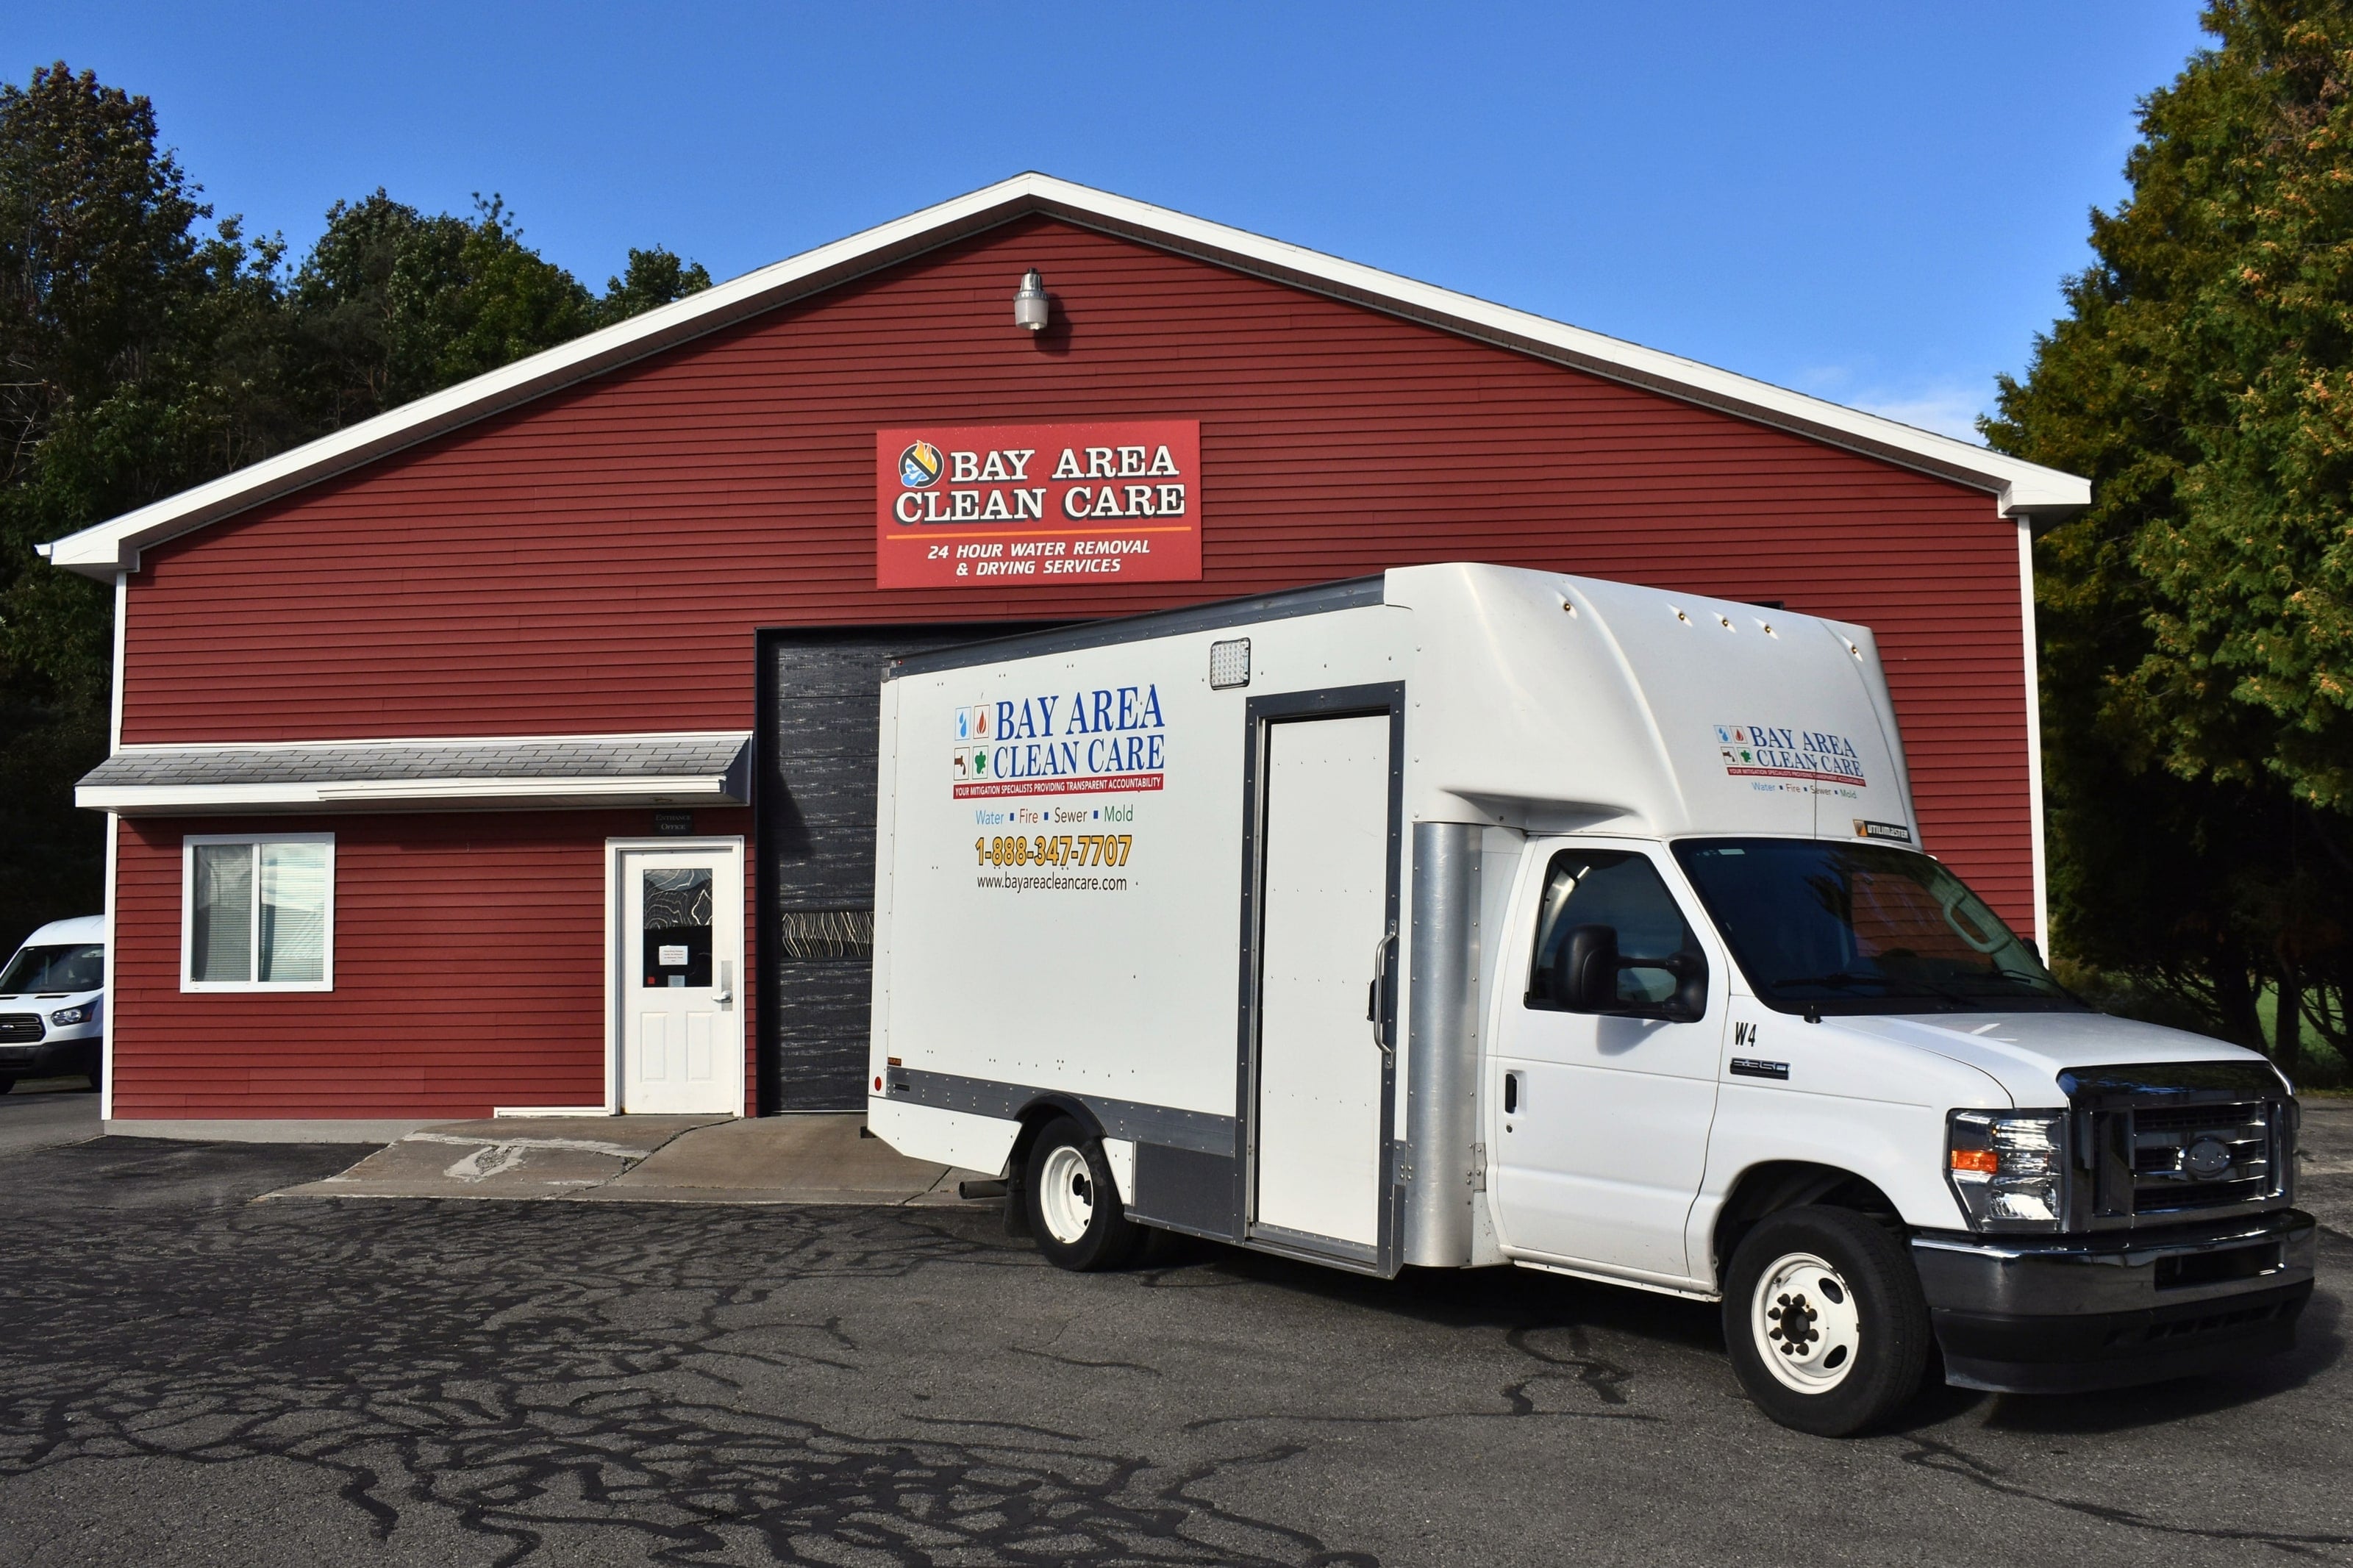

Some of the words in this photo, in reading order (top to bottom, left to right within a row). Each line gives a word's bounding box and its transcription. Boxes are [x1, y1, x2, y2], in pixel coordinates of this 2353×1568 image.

[949, 449, 1035, 482] BAY
[1051, 445, 1180, 479] AREA
[895, 488, 1046, 523] CLEAN
[1063, 484, 1185, 519] CARE
[927, 545, 949, 559] 24
[956, 544, 1003, 559] HOUR
[1010, 542, 1065, 557] WATER
[1073, 540, 1150, 555] REMOVAL
[956, 563, 969, 576] &
[976, 561, 1035, 576] DRYING
[1043, 559, 1121, 574] SERVICES
[995, 695, 1059, 741] BAY
[1065, 684, 1165, 735] AREA
[1747, 726, 1796, 749] BAY
[1802, 731, 1857, 759] AREA
[994, 741, 1079, 779] CLEAN
[1088, 734, 1165, 773] CARE
[1757, 749, 1817, 770] CLEAN
[1821, 755, 1864, 778] CARE
[955, 787, 970, 797] YOUR
[970, 785, 1001, 795] MITIGATION
[1001, 784, 1033, 794] SPECIALISTS
[1034, 782, 1065, 792] PROVIDING
[1066, 779, 1107, 790] TRANSPARENT
[1108, 777, 1161, 789] ACCOUNTABILITY
[1752, 781, 1775, 792] Water
[1785, 783, 1801, 793] Fire
[1810, 784, 1832, 796] Sewer
[1840, 788, 1857, 799] Mold
[976, 809, 1004, 826] Water
[1019, 808, 1038, 824] Fire
[1054, 807, 1088, 823] Sewer
[1104, 804, 1134, 822] Mold
[975, 834, 1132, 866] 1-888-347-7707
[976, 872, 1127, 893] www.bayareacleancare.com
[1735, 1022, 1757, 1047] W4
